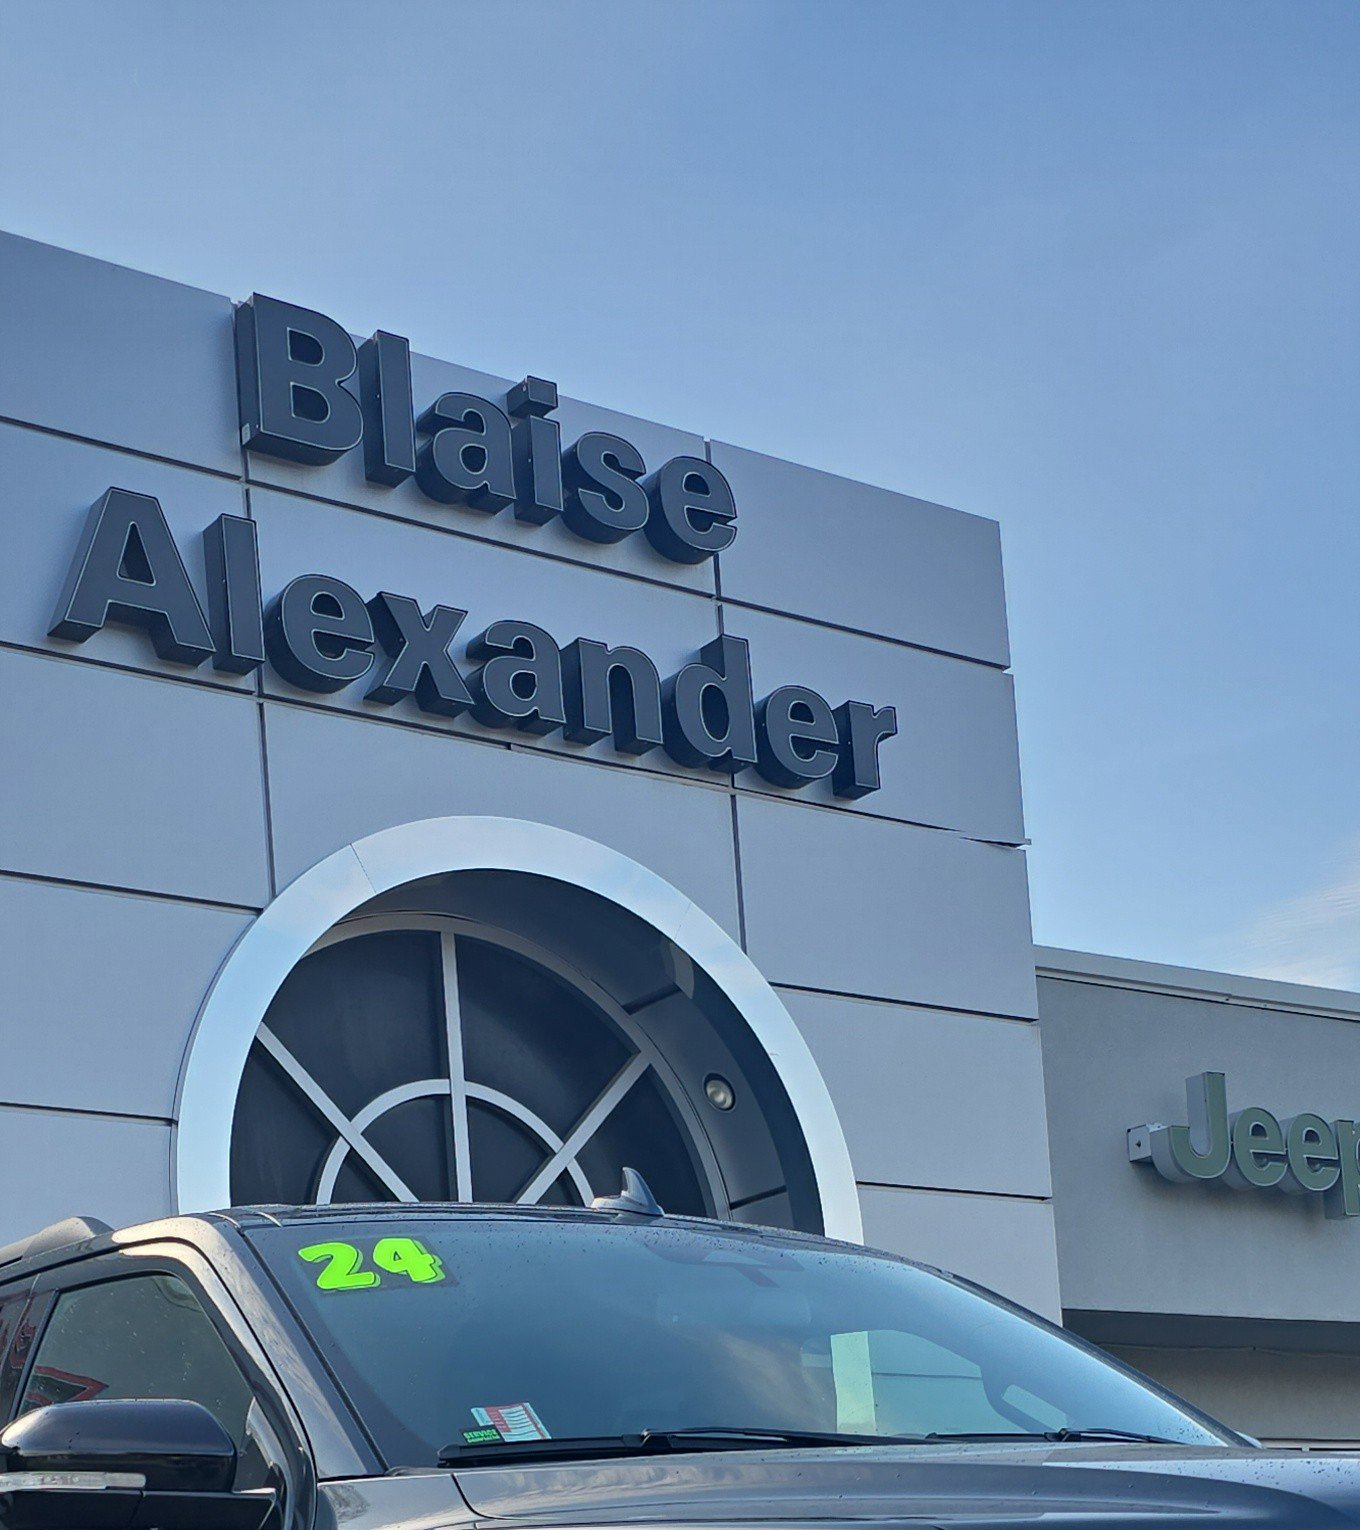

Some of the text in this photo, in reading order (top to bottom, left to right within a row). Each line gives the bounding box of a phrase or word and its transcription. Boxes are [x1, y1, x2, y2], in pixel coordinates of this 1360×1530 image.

[241, 291, 739, 565] Blaise
[47, 487, 897, 800] Alexander
[298, 1237, 445, 1291] 24
